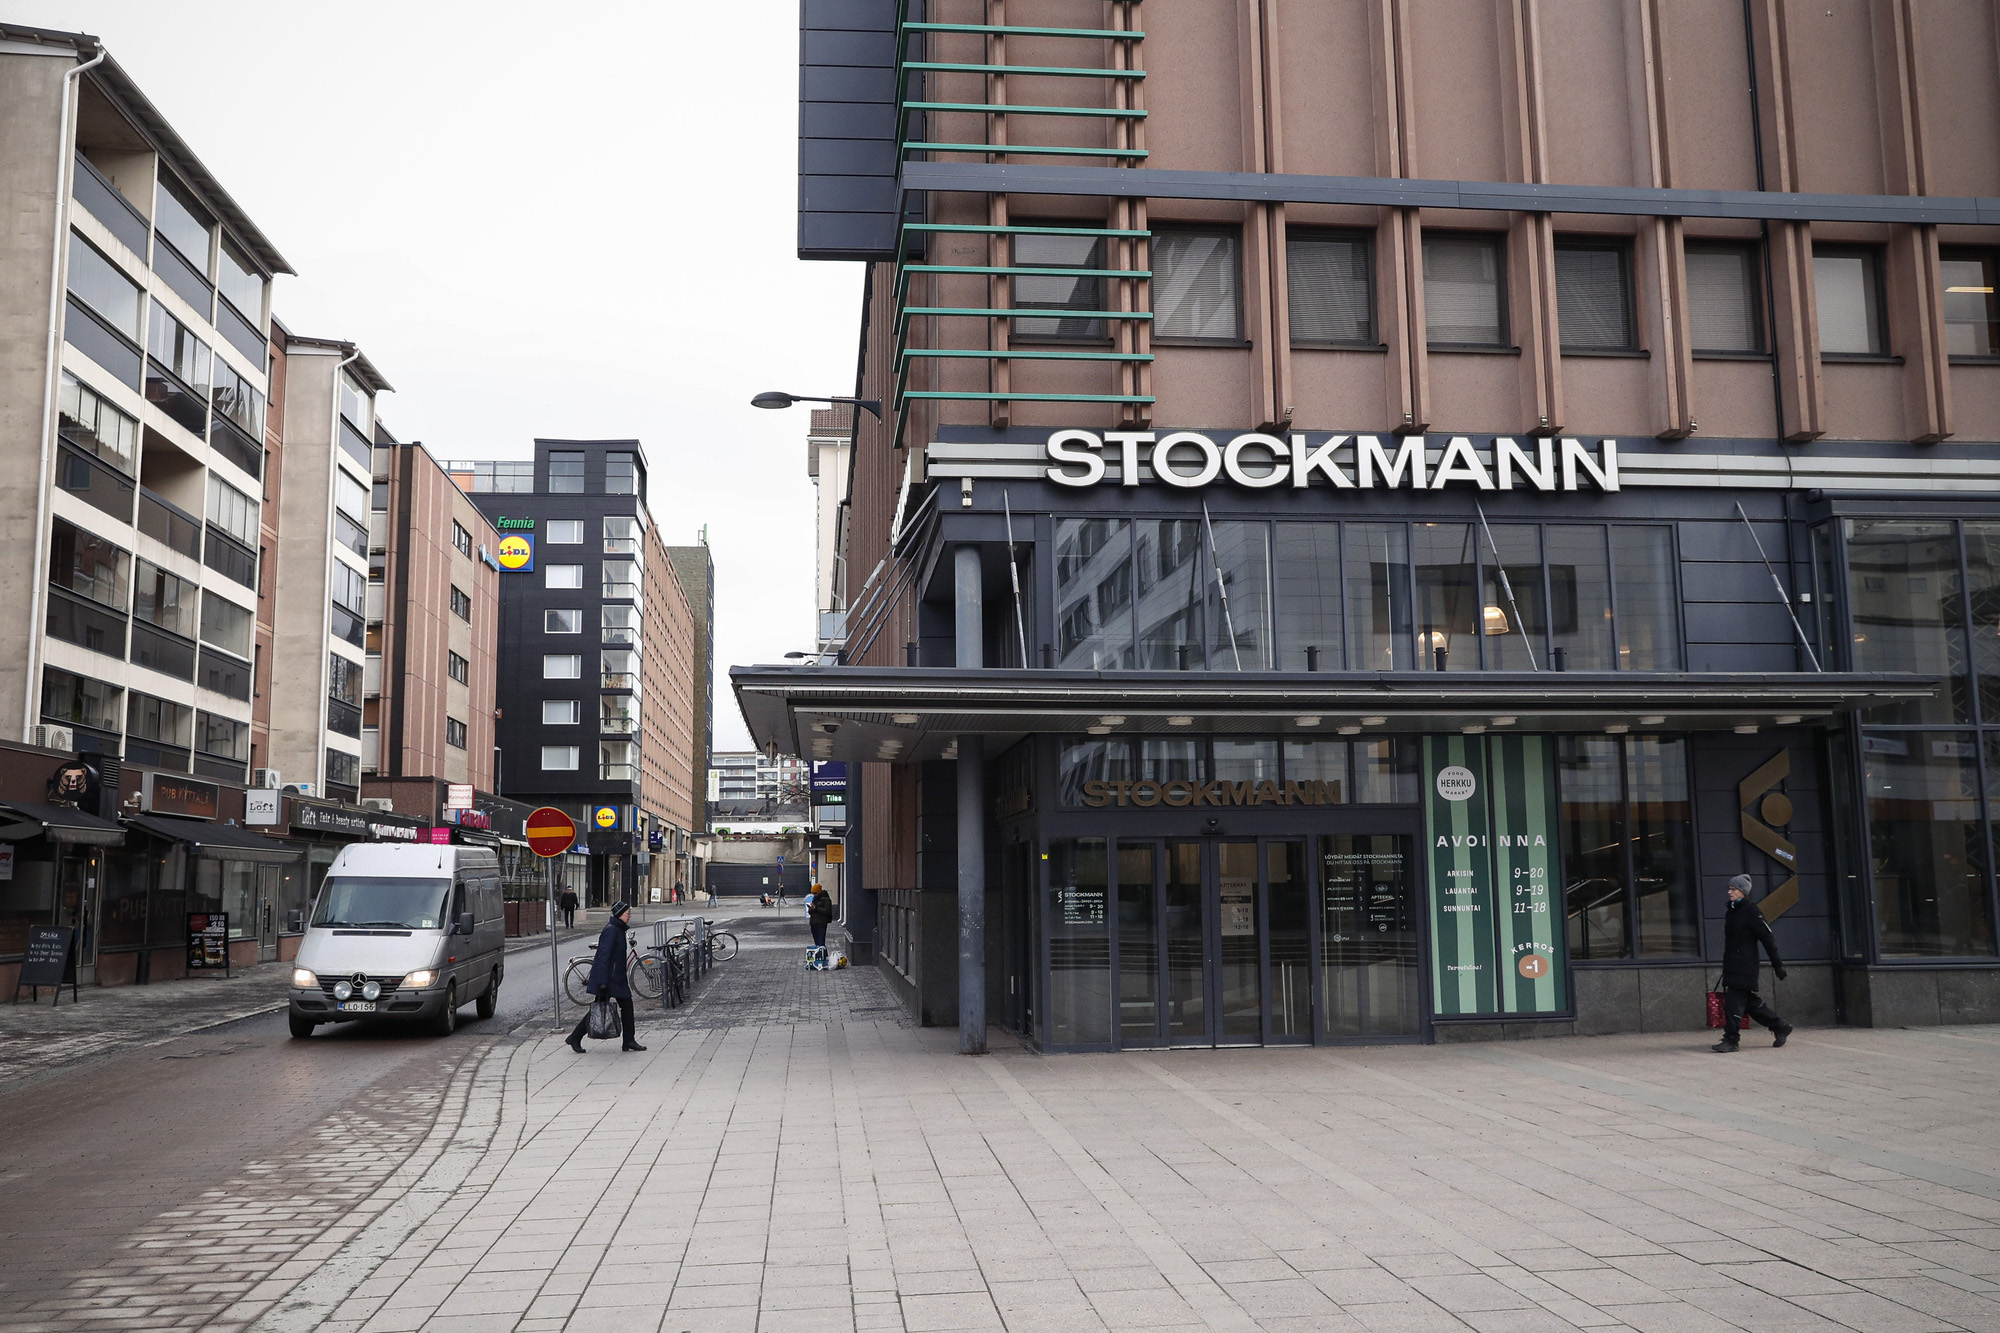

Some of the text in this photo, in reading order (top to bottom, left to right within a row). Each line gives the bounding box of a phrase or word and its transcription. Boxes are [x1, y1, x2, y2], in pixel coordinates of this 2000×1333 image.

[1045, 429, 1621, 494] STOCKMANN
[497, 516, 535, 529] Fennia
[1440, 779, 1472, 788] HERKKU
[161, 786, 177, 800] PUB
[1083, 779, 1342, 807] STOCKMANN
[250, 803, 274, 811] Loft
[302, 810, 317, 826] Loft
[1510, 942, 1555, 954] KERROS
[1526, 960, 1539, 973] -1
